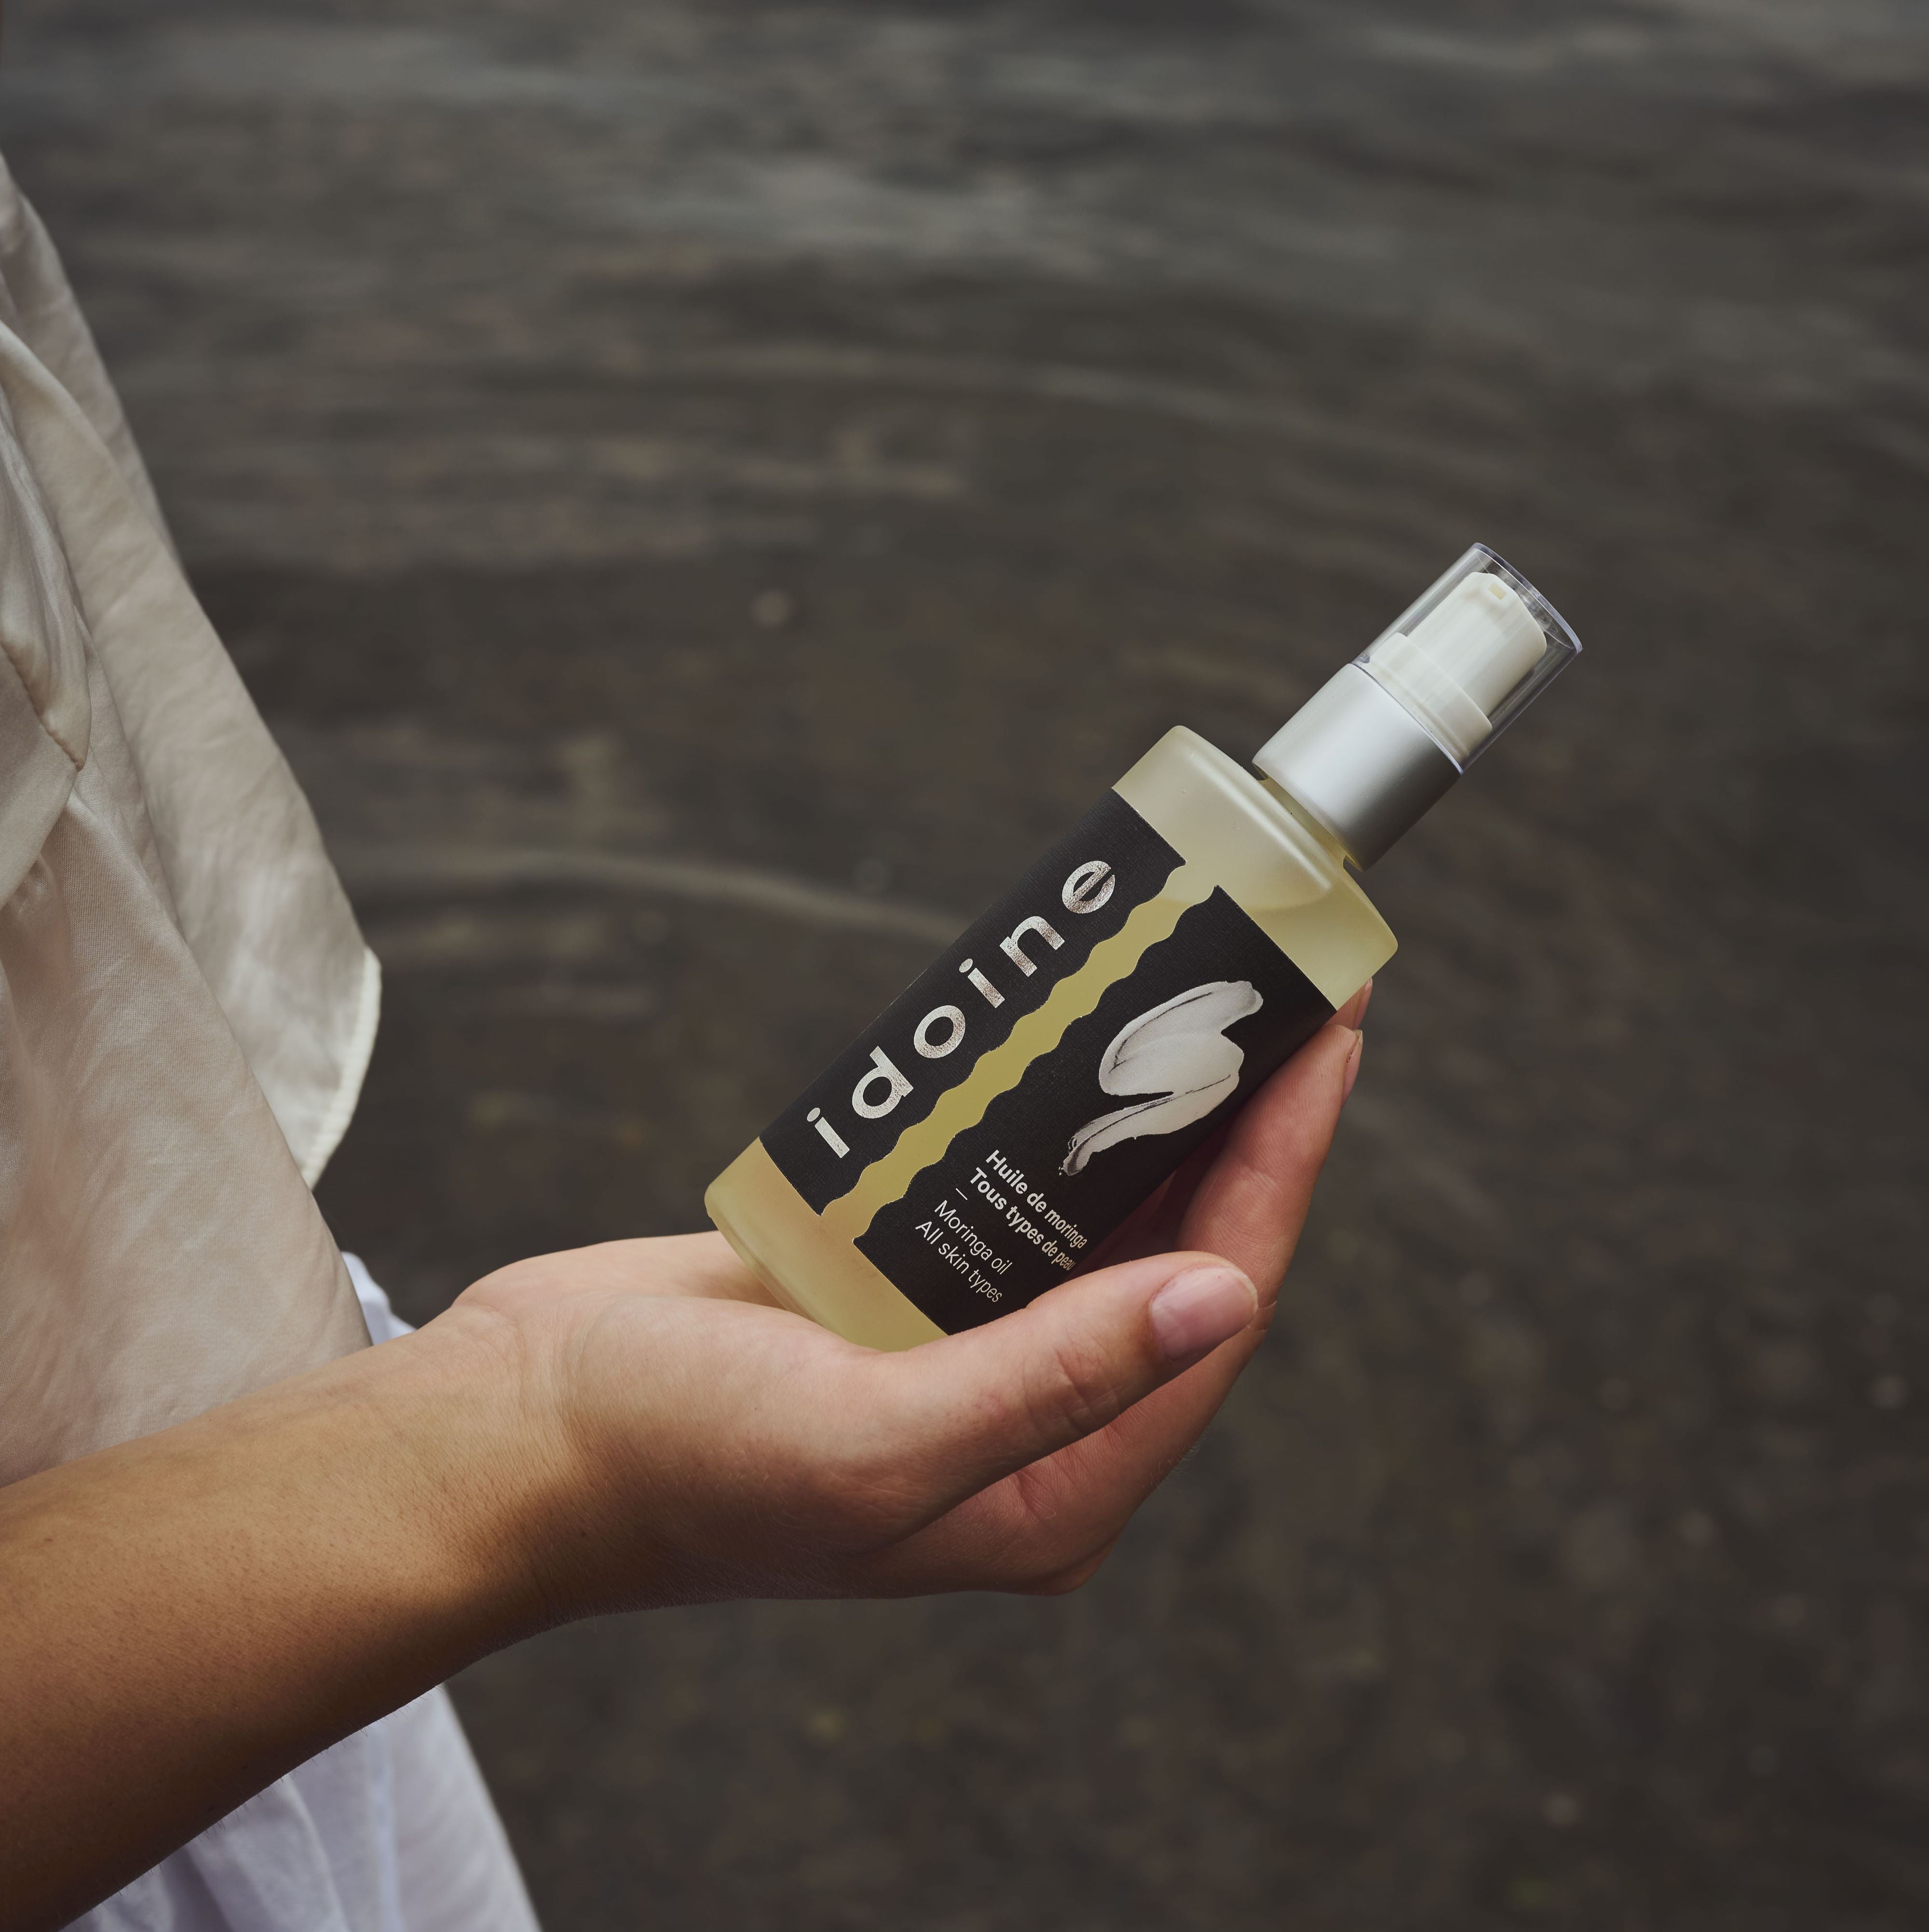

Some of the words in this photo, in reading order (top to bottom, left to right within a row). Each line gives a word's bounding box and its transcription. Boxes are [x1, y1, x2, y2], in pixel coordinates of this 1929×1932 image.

[807, 860, 1115, 1158] idoine
[934, 1200, 992, 1261] Moringa
[991, 1257, 1013, 1275] oil
[970, 1166, 1007, 1210] Tous
[1005, 1205, 1044, 1245] types
[1042, 1240, 1058, 1257] de
[1051, 1252, 1076, 1271] peau
[986, 1149, 1028, 1194] Huile
[1027, 1193, 1047, 1213] de
[1044, 1209, 1087, 1249] moringa
[915, 1221, 944, 1245] All
[938, 1243, 969, 1274] skin
[968, 1269, 1003, 1302] types
